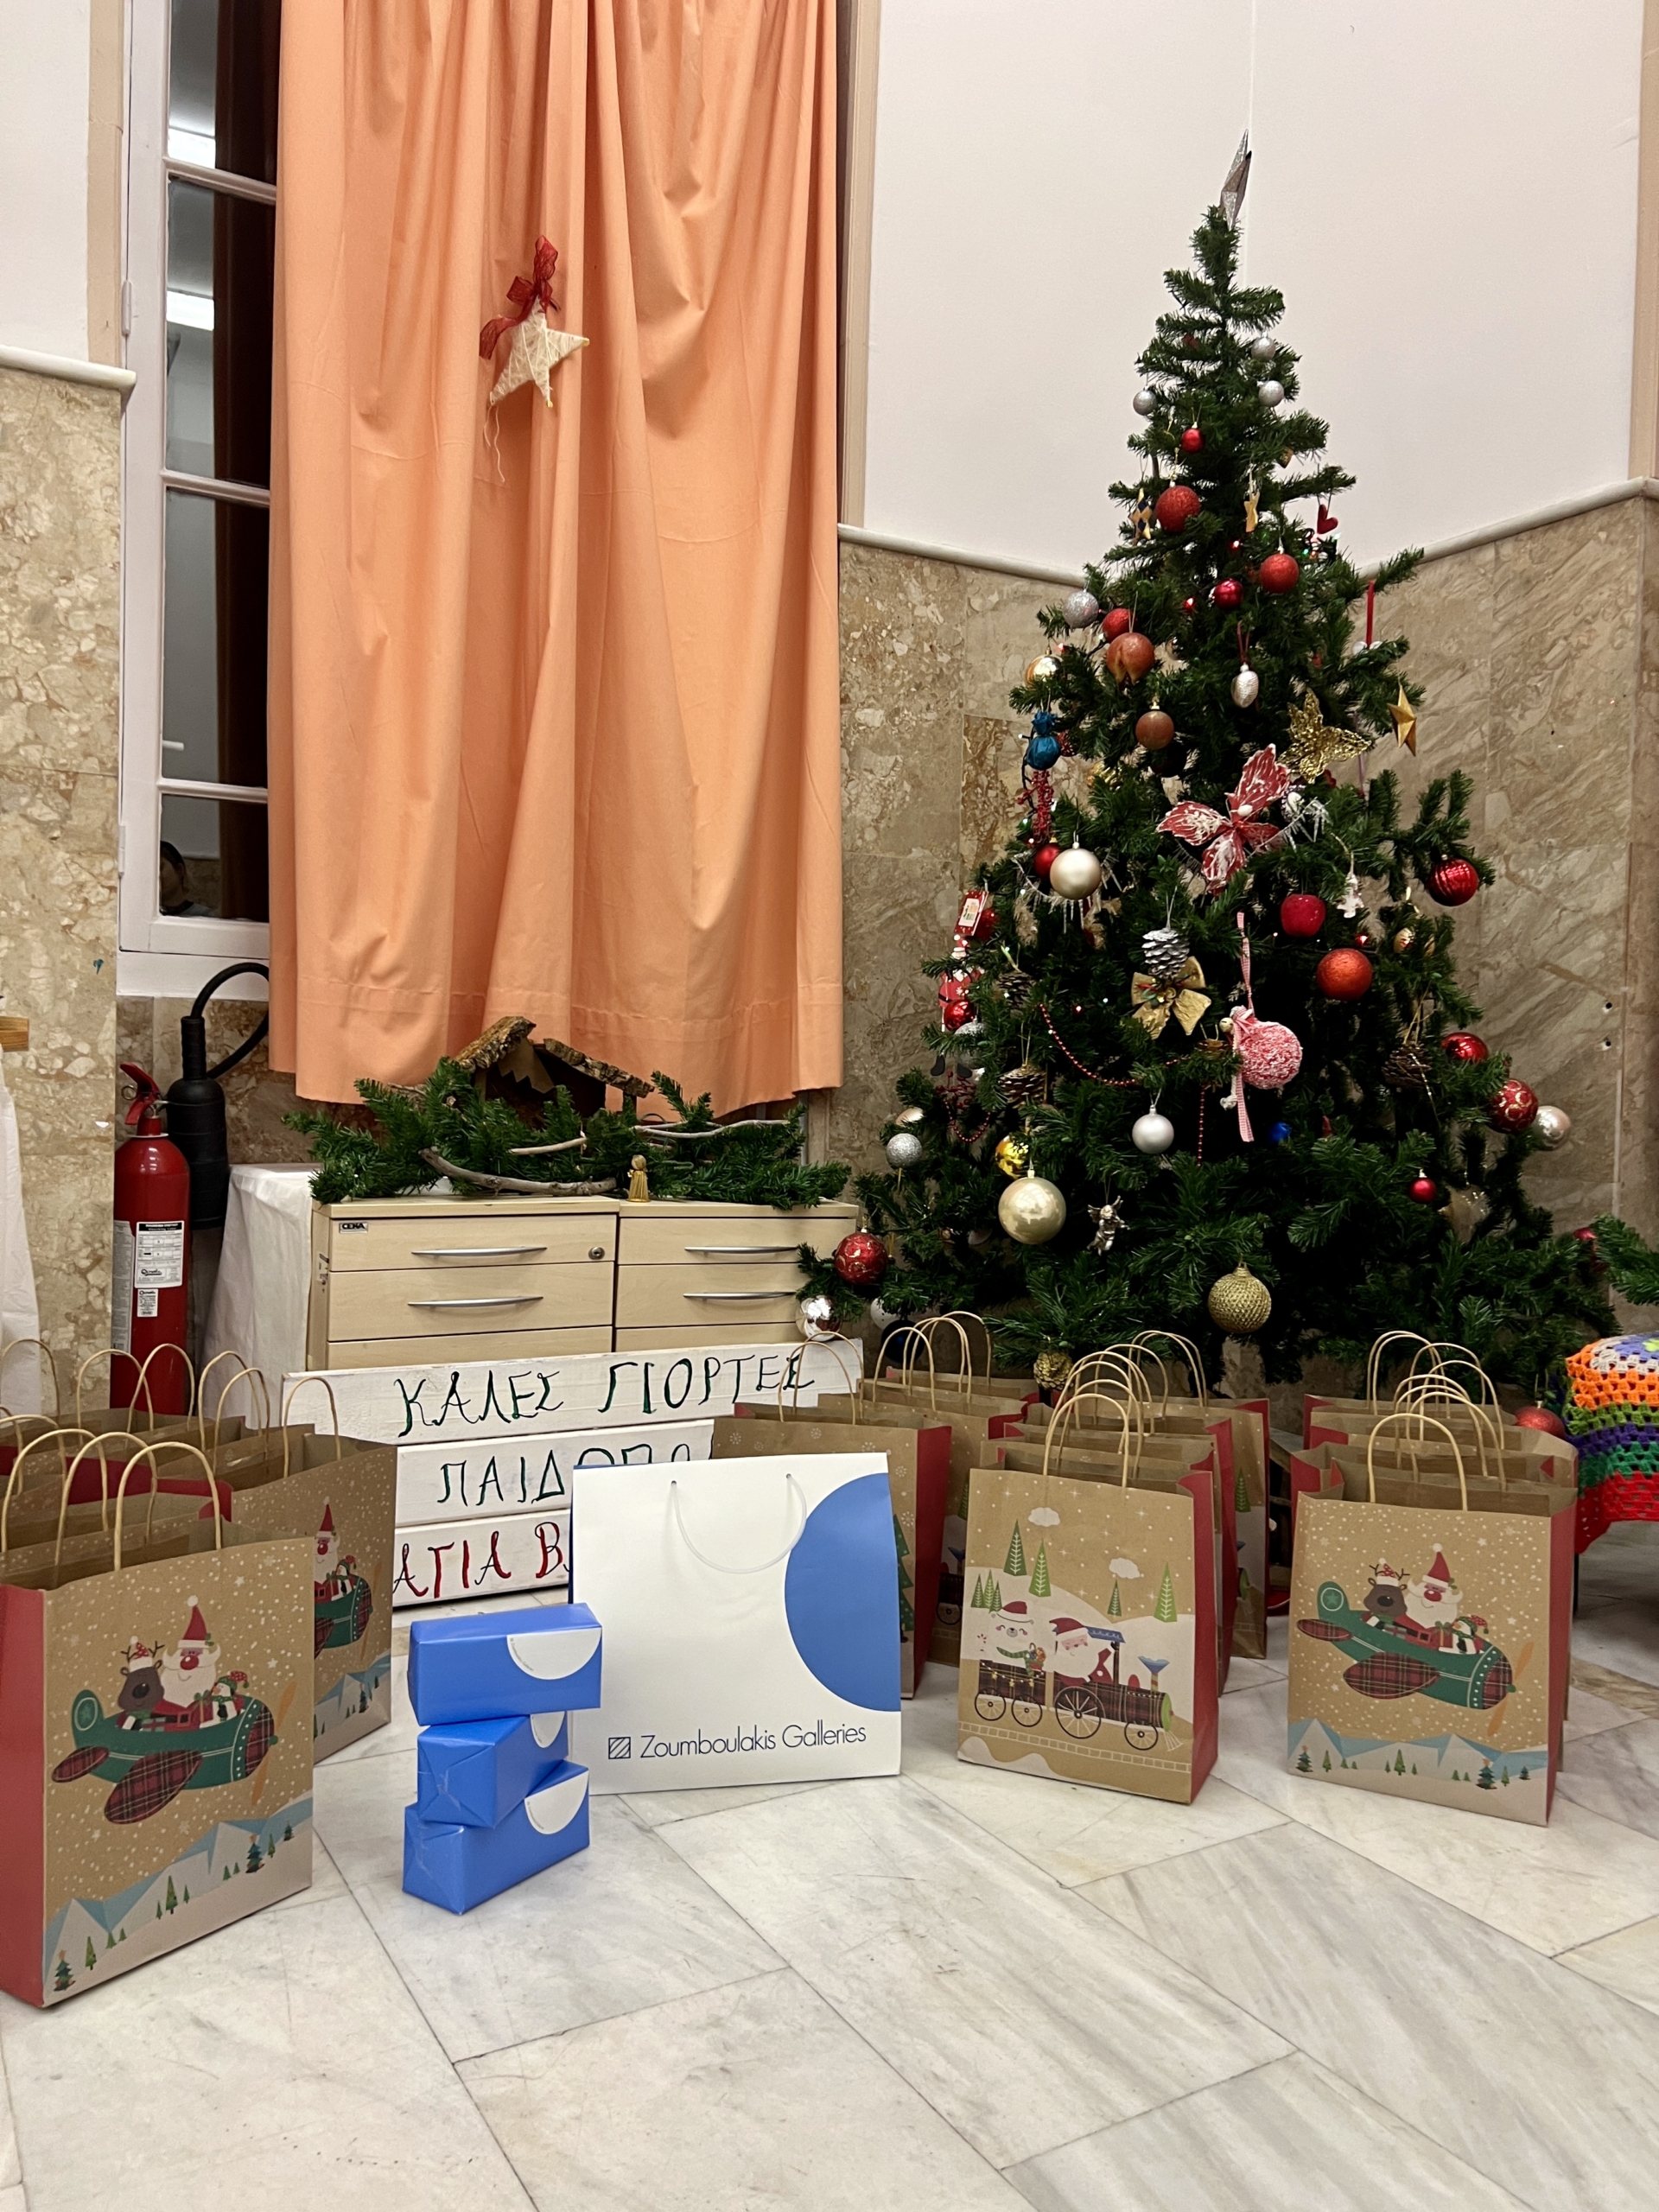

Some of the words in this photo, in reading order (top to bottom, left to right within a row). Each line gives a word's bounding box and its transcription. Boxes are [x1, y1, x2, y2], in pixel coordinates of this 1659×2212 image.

[394, 1370, 563, 1438] ΚΑΛΕΣ
[598, 1353, 815, 1414] ΓΙΟΡΤΕΣ
[640, 1724, 777, 1758] Zoumboulakis
[782, 1719, 867, 1748] Galleries
